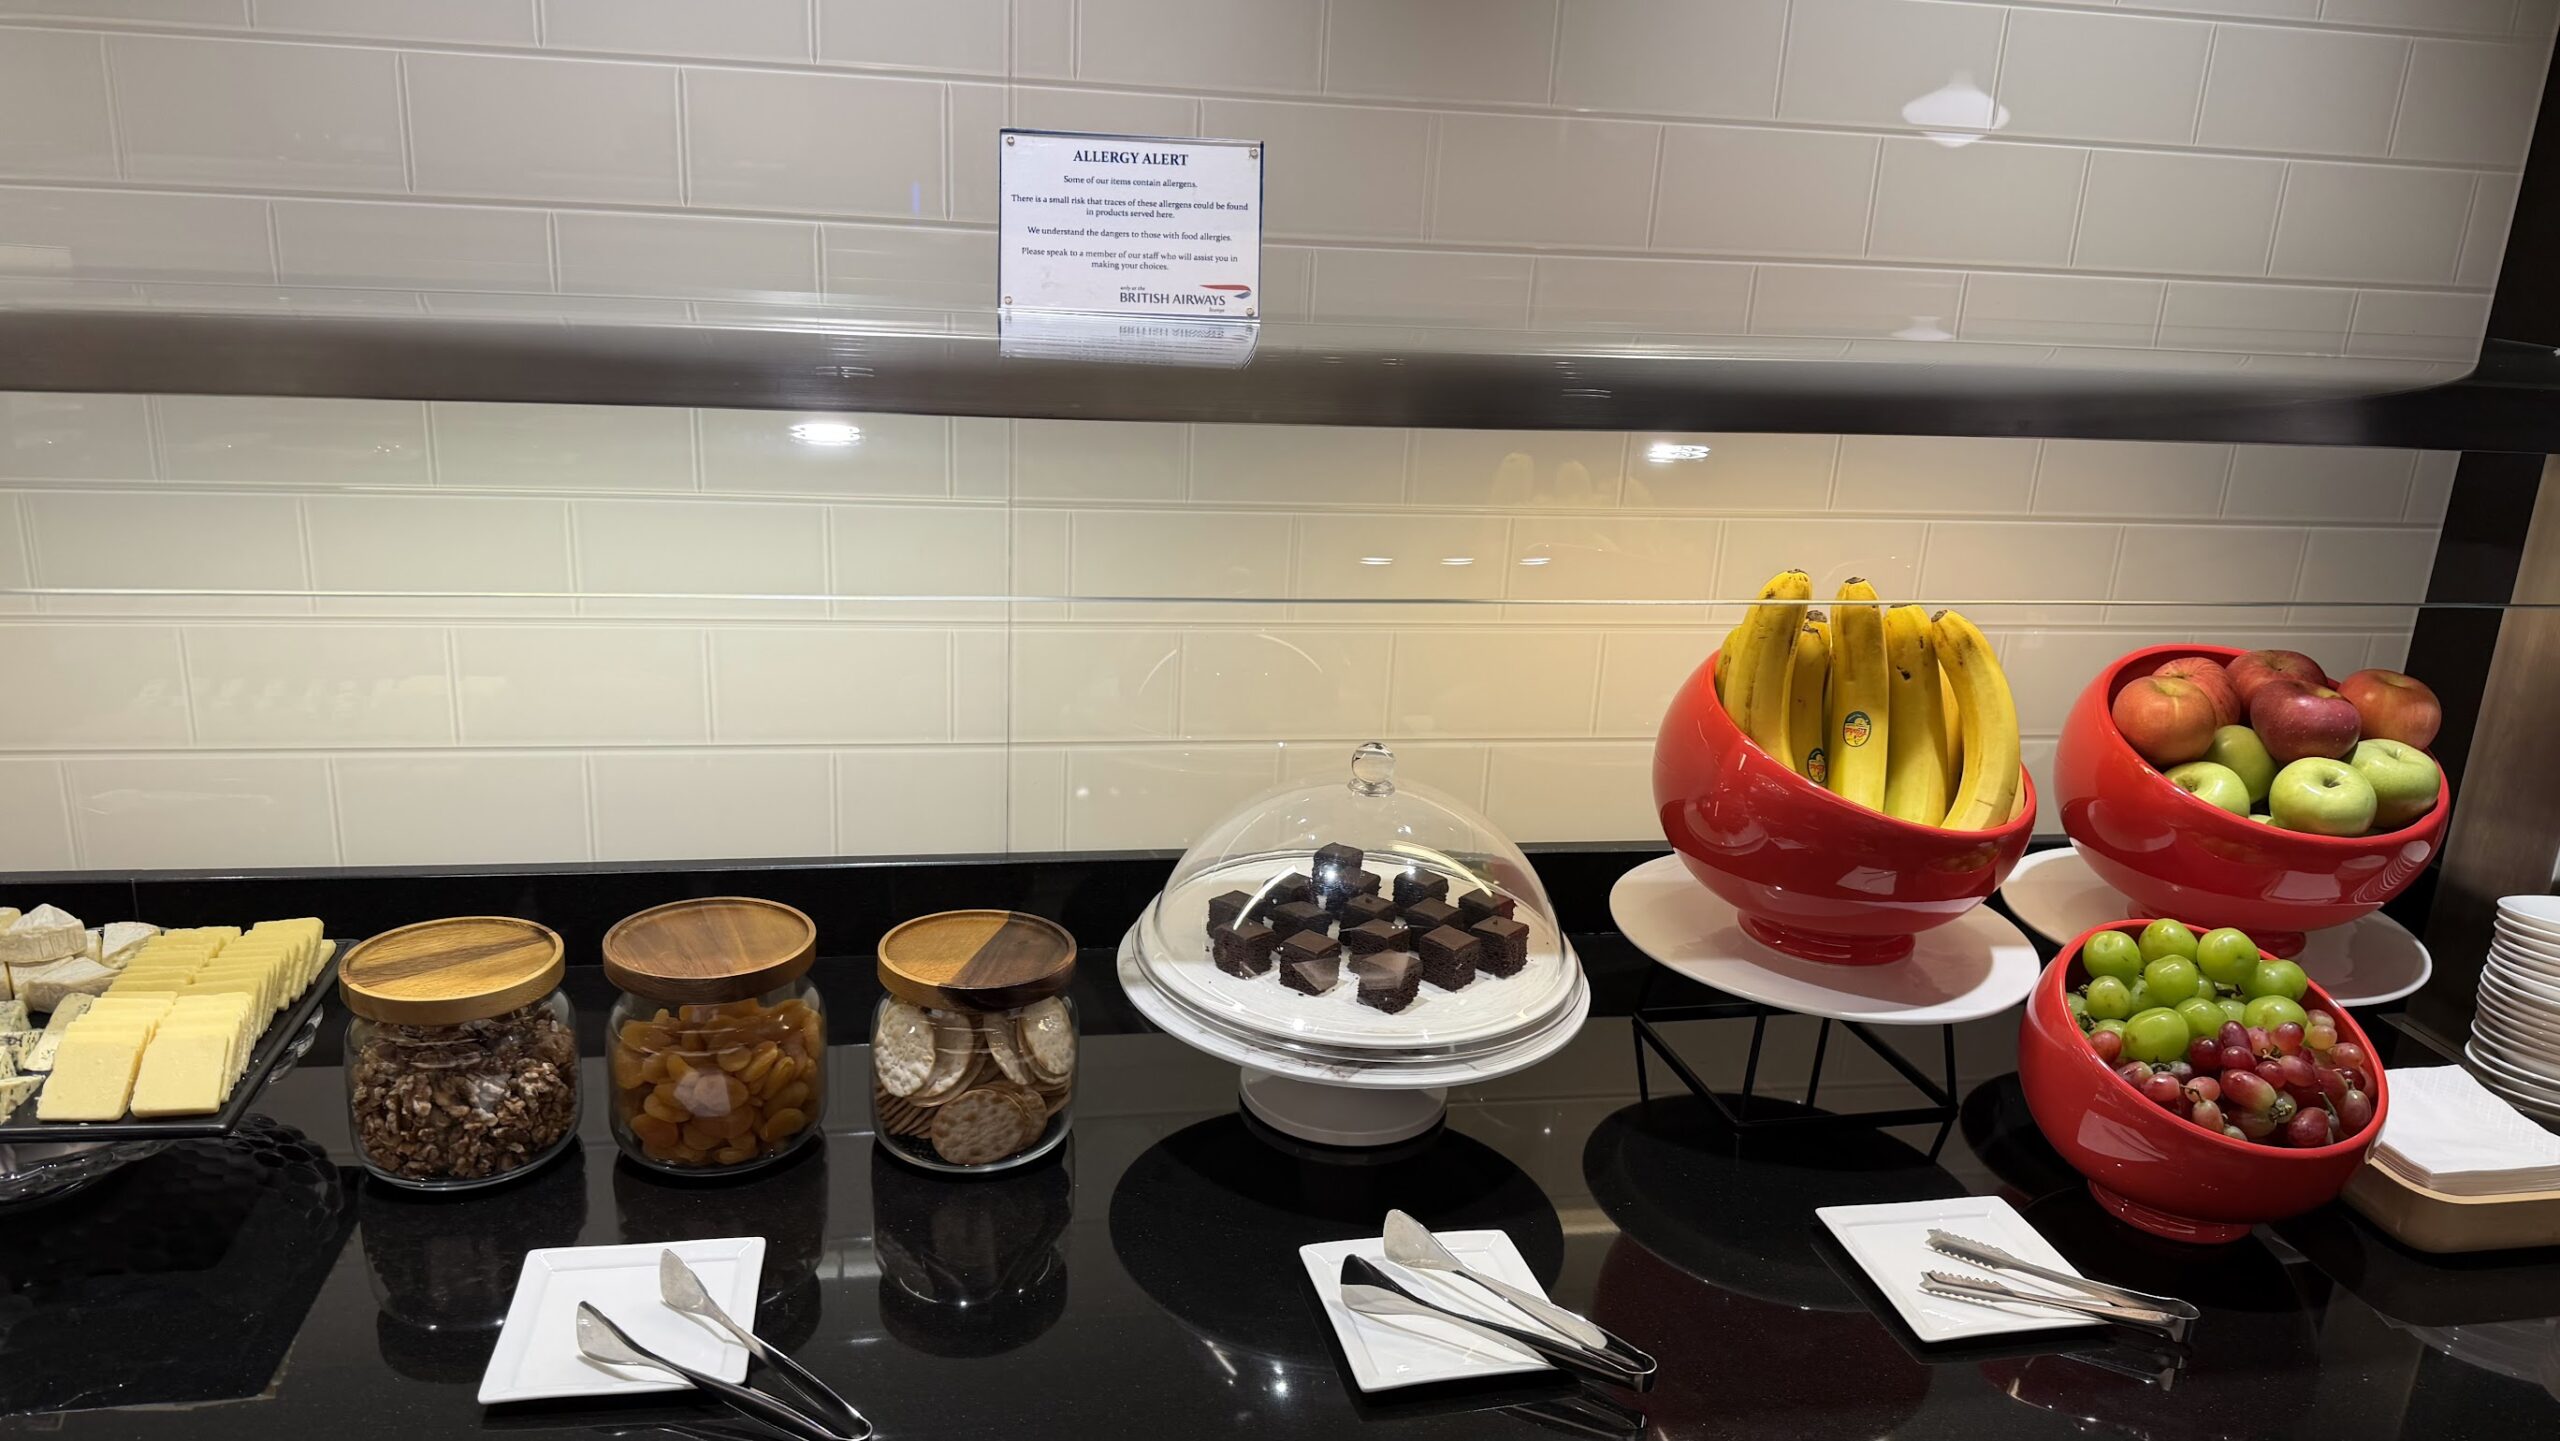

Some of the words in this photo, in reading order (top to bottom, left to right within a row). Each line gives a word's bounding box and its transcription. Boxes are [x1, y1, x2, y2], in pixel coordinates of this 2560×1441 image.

[1073, 150, 1139, 164] ALLERGY
[1142, 152, 1189, 166] ALERT
[1063, 175, 1084, 184] Some
[1086, 175, 1094, 185] of
[1110, 177, 1131, 186] items
[1133, 177, 1161, 186] contain
[1162, 177, 1198, 188] allergens.
[1011, 194, 1033, 203] There
[1035, 195, 1041, 204] is
[1049, 196, 1070, 205] small
[1071, 196, 1086, 205] risk
[1087, 196, 1103, 206] that
[1104, 198, 1126, 207] traces
[1128, 198, 1136, 207] of
[1137, 198, 1158, 208] these
[1159, 199, 1192, 210] allergens
[1193, 201, 1215, 210] could
[1216, 201, 1225, 210] be
[1226, 202, 1249, 210] found
[1086, 208, 1094, 216] in
[1095, 208, 1129, 218] products
[1130, 210, 1155, 218] served
[1156, 210, 1175, 219] here.
[1027, 226, 1040, 235] We
[1042, 227, 1085, 236] understand
[1086, 228, 1099, 237] the
[1100, 228, 1130, 239] dangers
[1141, 230, 1162, 238] those
[1163, 230, 1180, 239] with
[1181, 231, 1198, 241] food
[1199, 232, 1232, 242] allergies.
[1022, 247, 1045, 256] Please
[1046, 248, 1068, 259] speak
[1085, 249, 1117, 258] member
[1118, 250, 1127, 259] of
[1142, 251, 1159, 260] staff
[1160, 251, 1177, 260] who
[1178, 252, 1192, 261] will
[1193, 253, 1214, 262] assist
[1215, 255, 1229, 264] you
[1230, 254, 1238, 263] in
[1091, 260, 1120, 270] making
[1121, 262, 1138, 271] your
[1139, 261, 1169, 271] choices.
[1120, 292, 1170, 304] BRITISH
[1172, 294, 1226, 306] AIRWAYS
